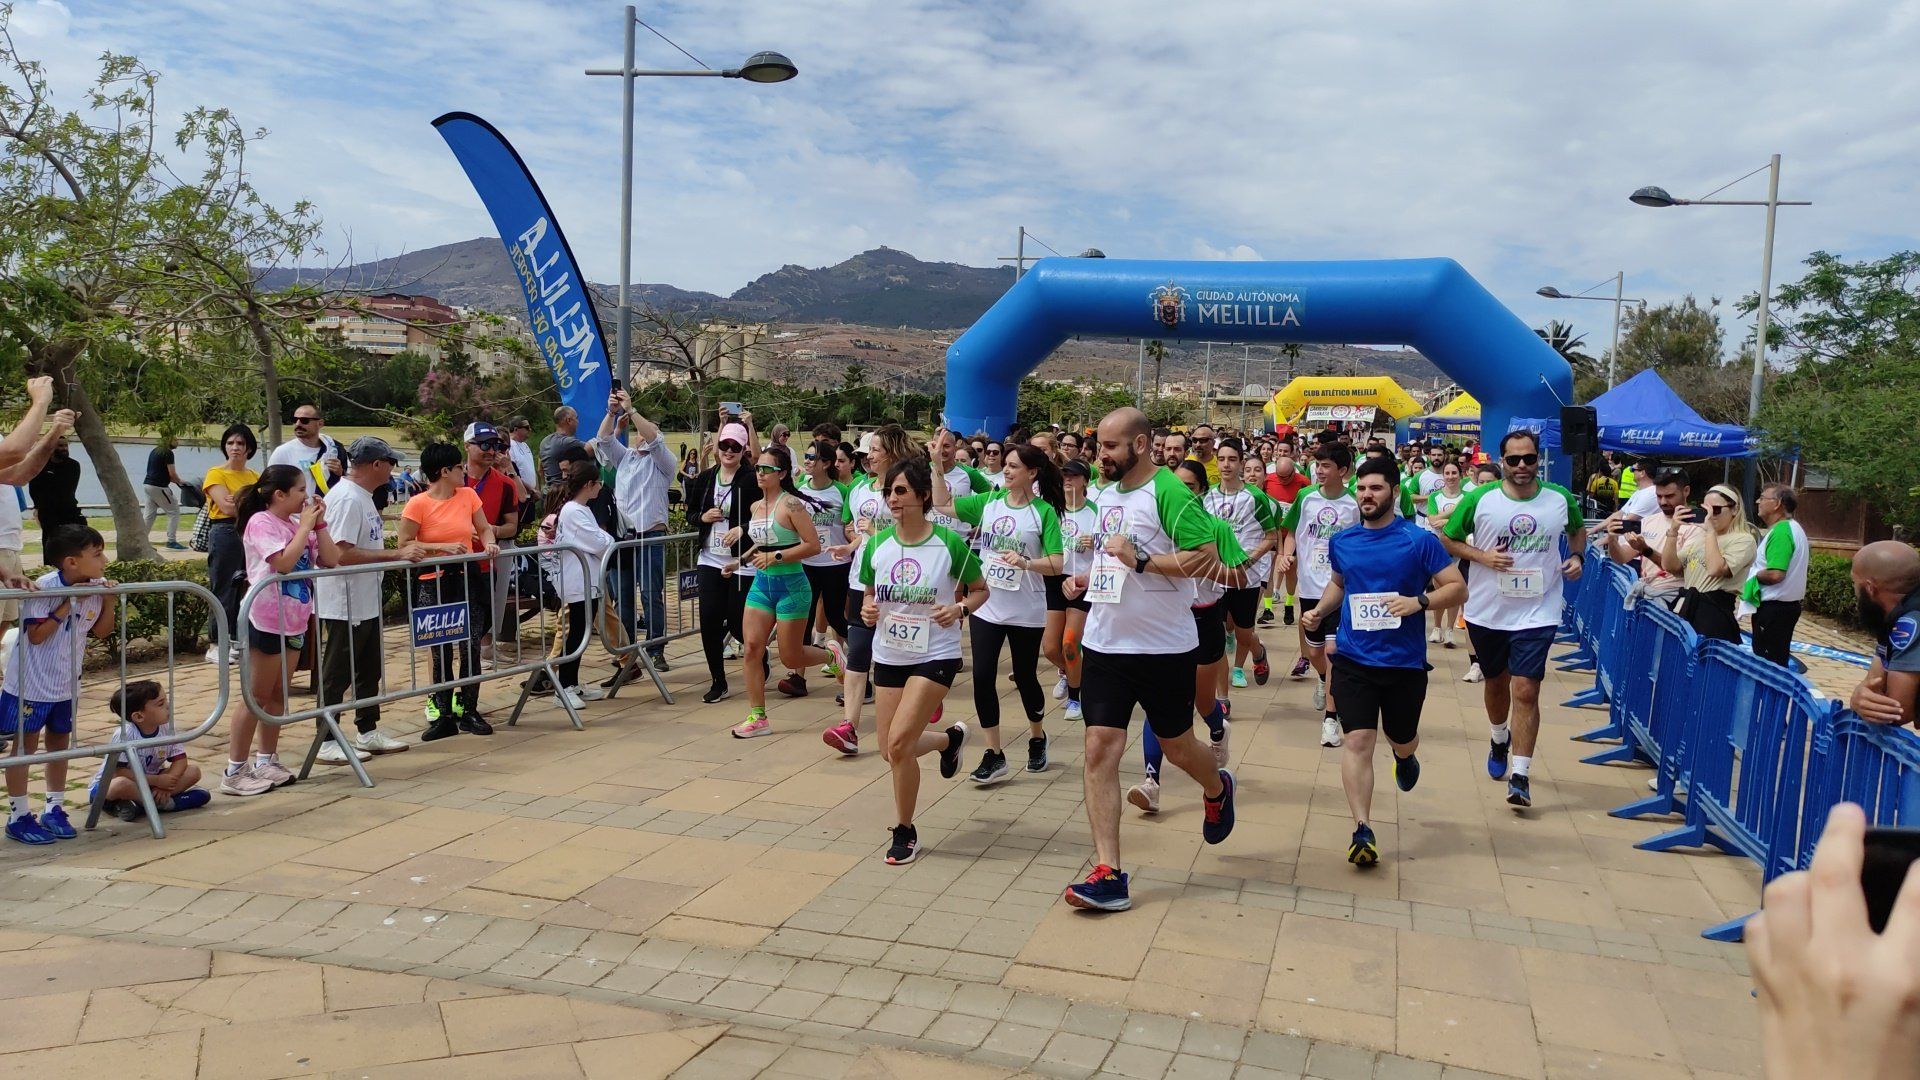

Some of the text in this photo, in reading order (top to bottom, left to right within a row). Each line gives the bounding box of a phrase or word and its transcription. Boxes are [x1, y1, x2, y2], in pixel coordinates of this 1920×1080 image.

[1196, 290, 1300, 303] CIUDAD AUTÓNOMA
[1197, 303, 1301, 327] MELILLA
[1303, 388, 1378, 397] CLUB ATLÉTICO MELILLA
[1620, 428, 1665, 442] MELILLA
[1678, 430, 1723, 444] MELILLA
[933, 515, 953, 525] 489
[751, 527, 768, 539] 371
[988, 564, 1016, 582] 502
[1093, 573, 1115, 590] 421
[1511, 577, 1530, 589] 11
[1359, 603, 1392, 619] 362
[416, 608, 465, 633] MELILLA
[888, 622, 921, 641] 437
